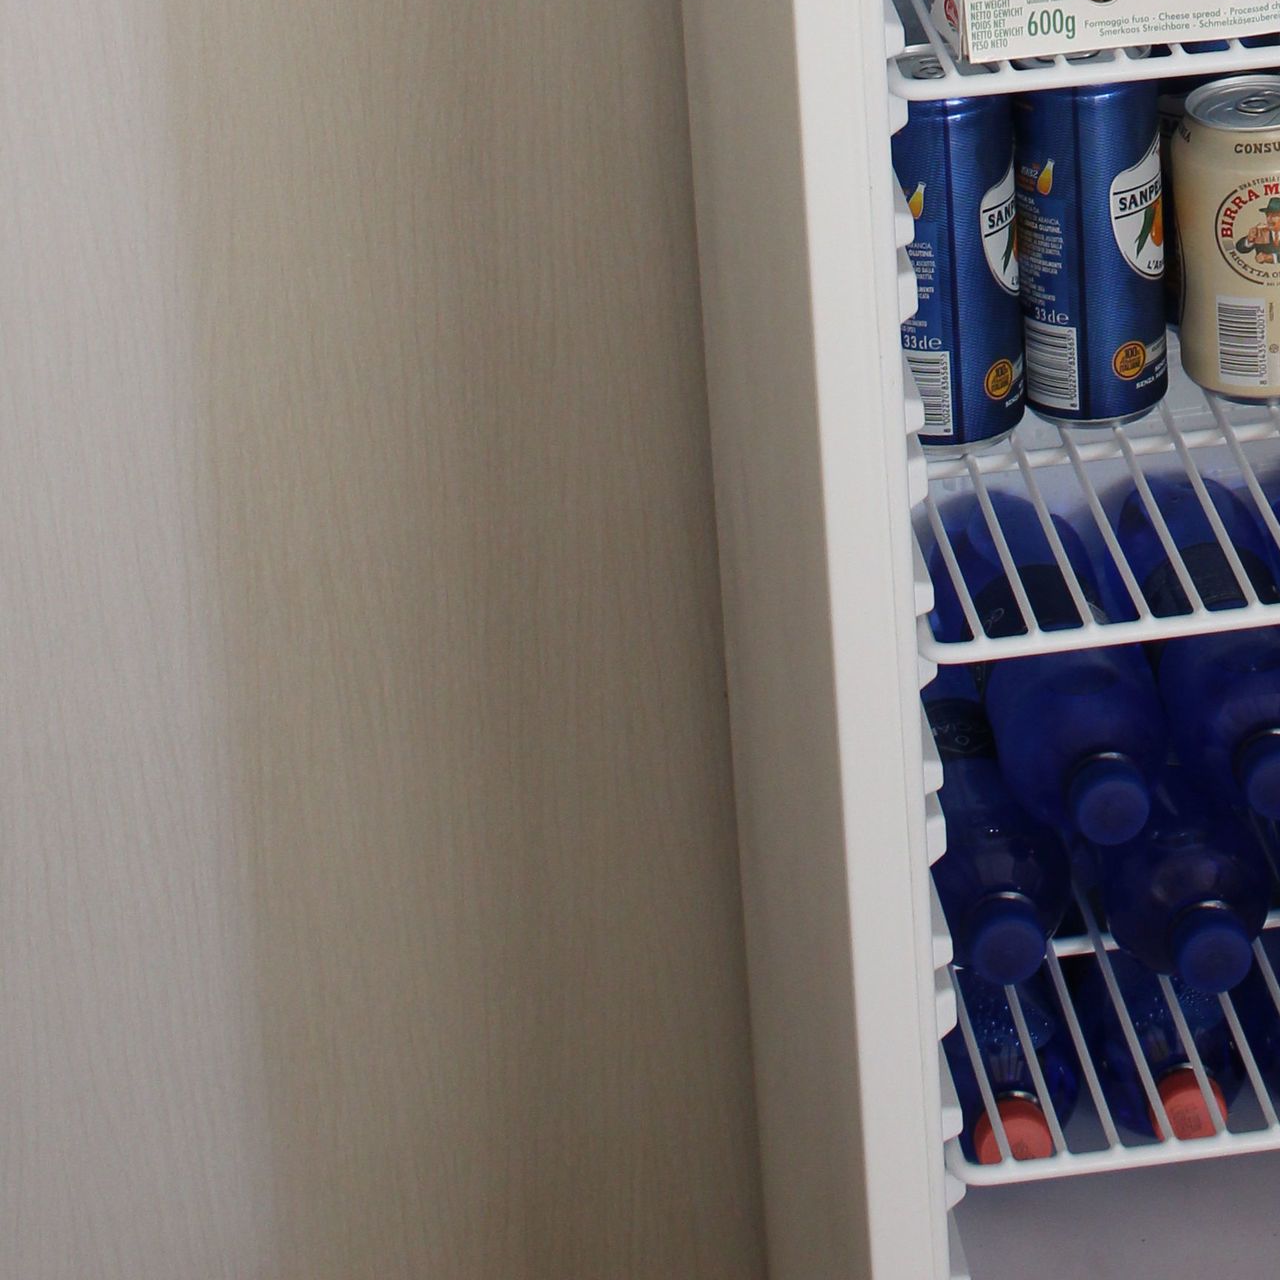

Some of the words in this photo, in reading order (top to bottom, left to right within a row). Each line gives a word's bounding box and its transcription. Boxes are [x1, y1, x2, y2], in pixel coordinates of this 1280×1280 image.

[970, 1, 984, 11] NET
[971, 11, 992, 21] NETTO
[993, 7, 1023, 18] GEWICHT
[1084, 17, 1130, 29] Formaggio
[1131, 15, 1150, 23] fuso
[1158, 12, 1190, 21] Cheese
[1192, 8, 1221, 20] spread
[1229, 4, 1270, 16] Processed
[971, 20, 992, 31] POIDS
[993, 19, 1006, 28] NET
[1027, 8, 1076, 40] 600g
[1099, 27, 1140, 37] Smerkaas
[1143, 22, 1190, 33] Streichbare
[971, 30, 992, 41] NETTO
[994, 26, 1024, 38] GEWICHT
[972, 41, 988, 51] PESO
[990, 38, 1008, 48] NETO
[1220, 188, 1261, 239] BIRRA
[1229, 249, 1270, 279] RICETTA
